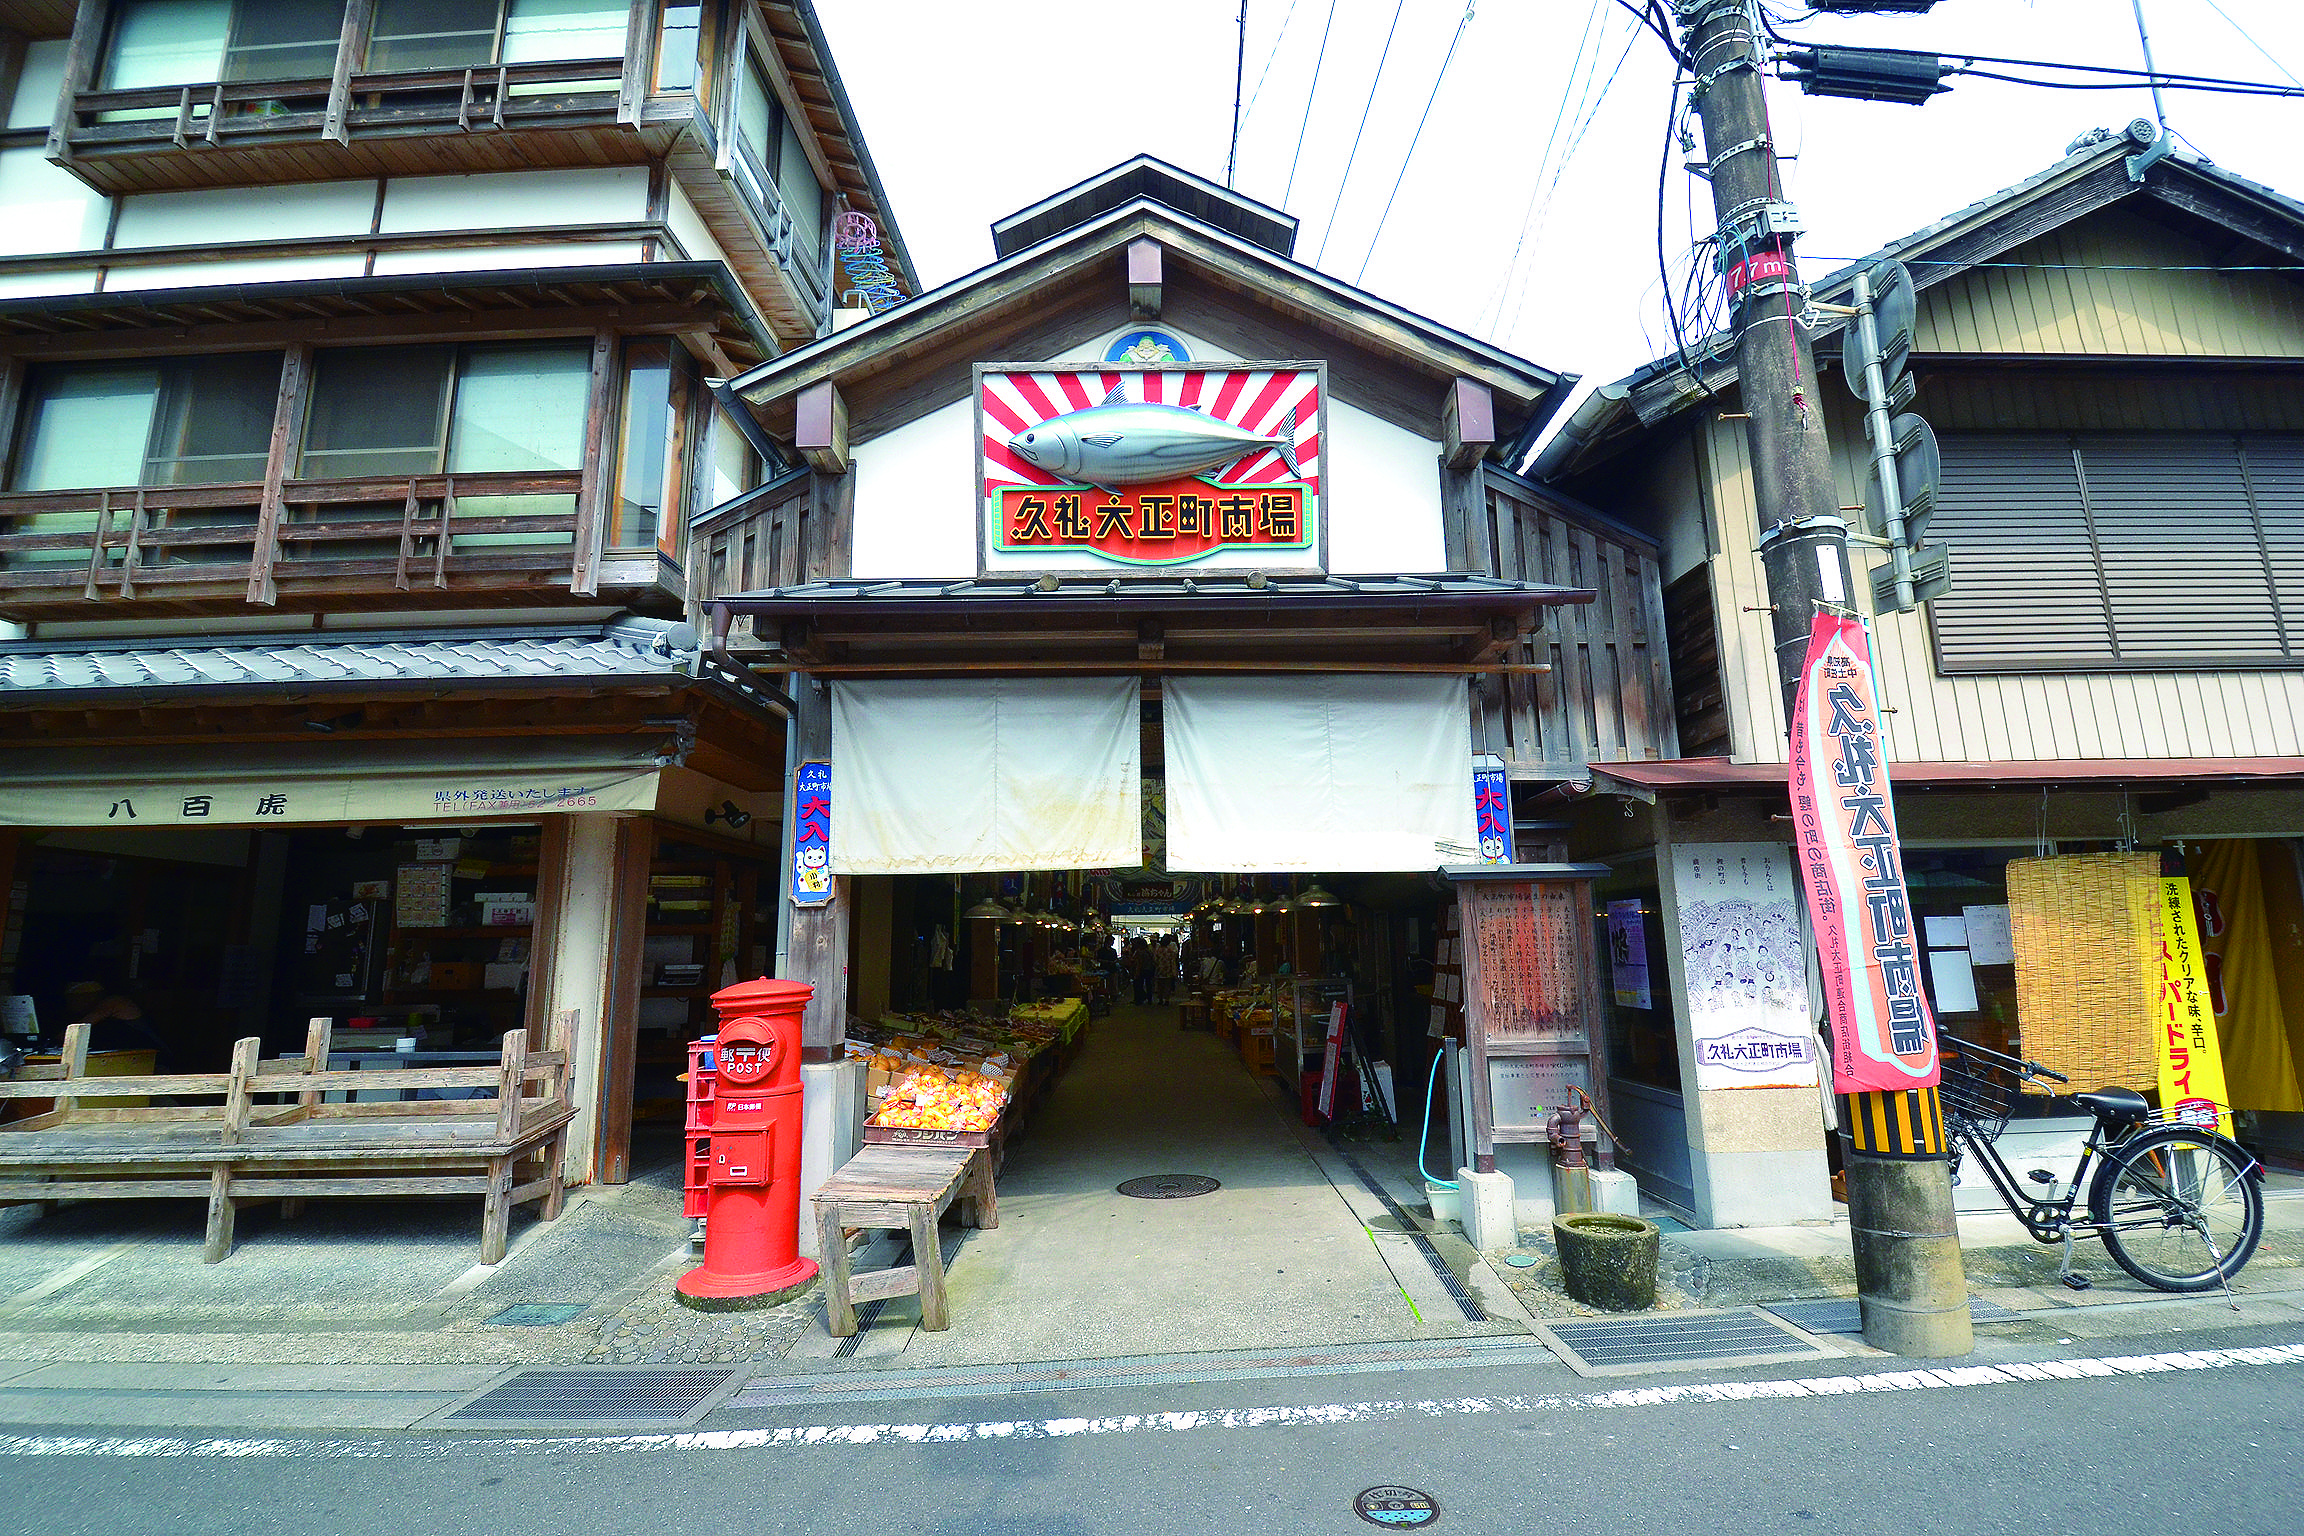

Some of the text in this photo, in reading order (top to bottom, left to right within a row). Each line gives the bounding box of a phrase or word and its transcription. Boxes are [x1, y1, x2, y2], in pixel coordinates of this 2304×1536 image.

[1010, 494, 1297, 540] 久礼大正町市場
[108, 793, 288, 818] 八百虎
[2165, 881, 2208, 1054] 洗練されたクリアな味、辛口。
[1707, 1041, 1803, 1060] 久礼大正町市場
[726, 1062, 763, 1074] POST
[911, 1130, 958, 1141] フジパン
